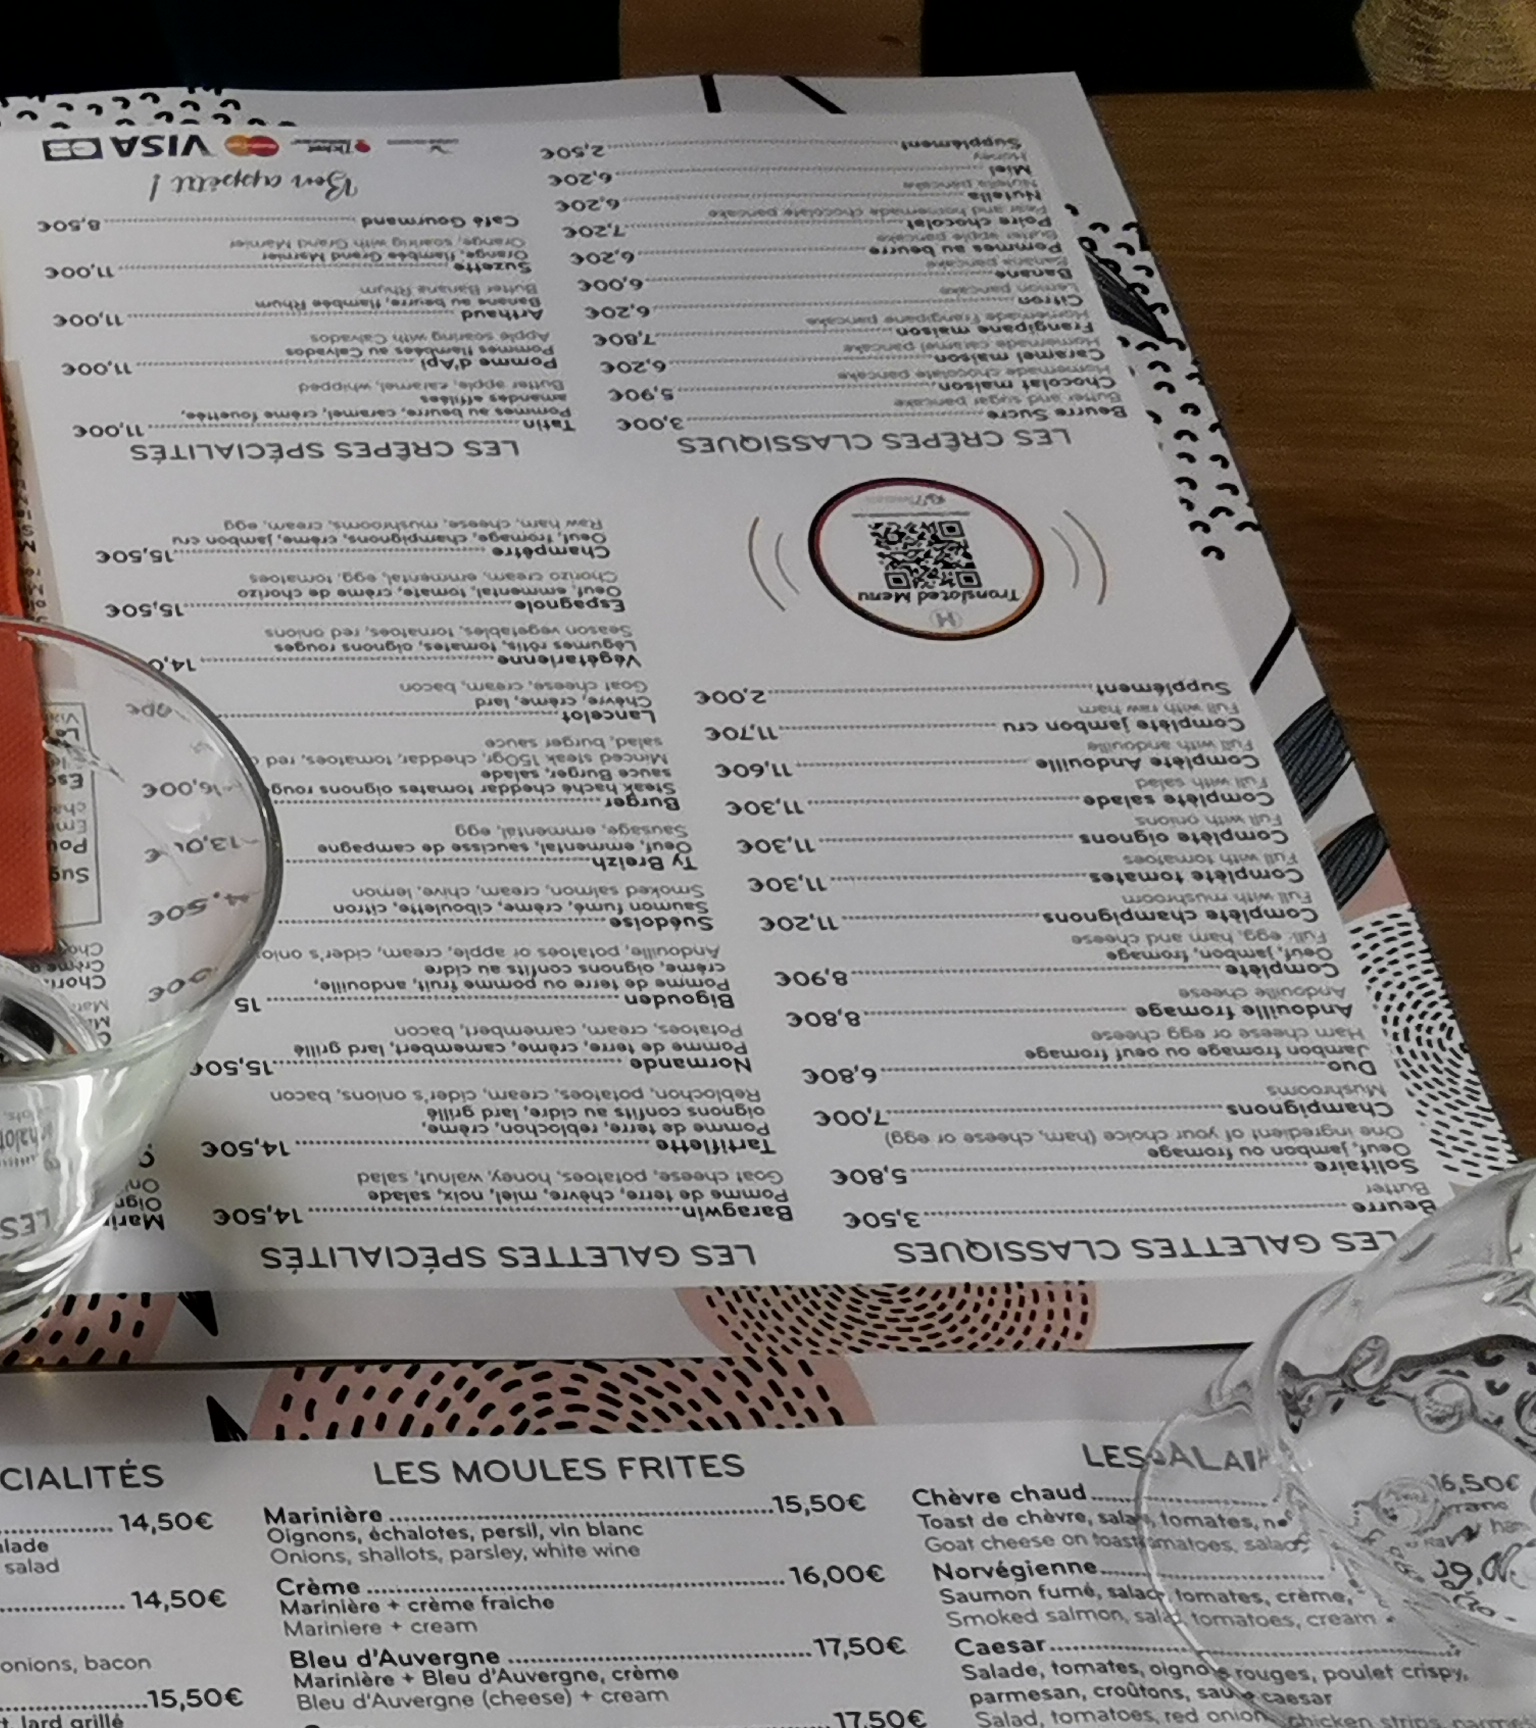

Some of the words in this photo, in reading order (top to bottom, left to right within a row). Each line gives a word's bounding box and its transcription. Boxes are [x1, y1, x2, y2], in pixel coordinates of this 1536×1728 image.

[110, 135, 210, 157] VISA
[130, 442, 324, 464] SPÉCIALITÉS
[334, 441, 454, 461] CRÊPES
[463, 440, 519, 457] LES
[213, 1205, 303, 1225] 14,50€
[682, 1202, 793, 1222] Baragwin
[498, 1246, 680, 1268] GALETTES
[690, 1245, 756, 1266] LES
[894, 1239, 1120, 1263] CLASSIQUES
[1131, 1234, 1320, 1259] GALETTES
[261, 1246, 486, 1274] SPÉCIALITÉS
[374, 1461, 440, 1485] LES
[452, 1458, 606, 1483] MOULES
[618, 1454, 744, 1480] FRITES
[912, 1488, 1001, 1506] Chèvre
[1010, 1483, 1086, 1502] chaud
[264, 1505, 382, 1525] Marinière
[772, 1494, 866, 1516] 15,50€
[119, 1512, 213, 1535] 14,50€
[933, 1560, 1097, 1582] Norvégienne
[147, 1688, 243, 1712] 15,50€
